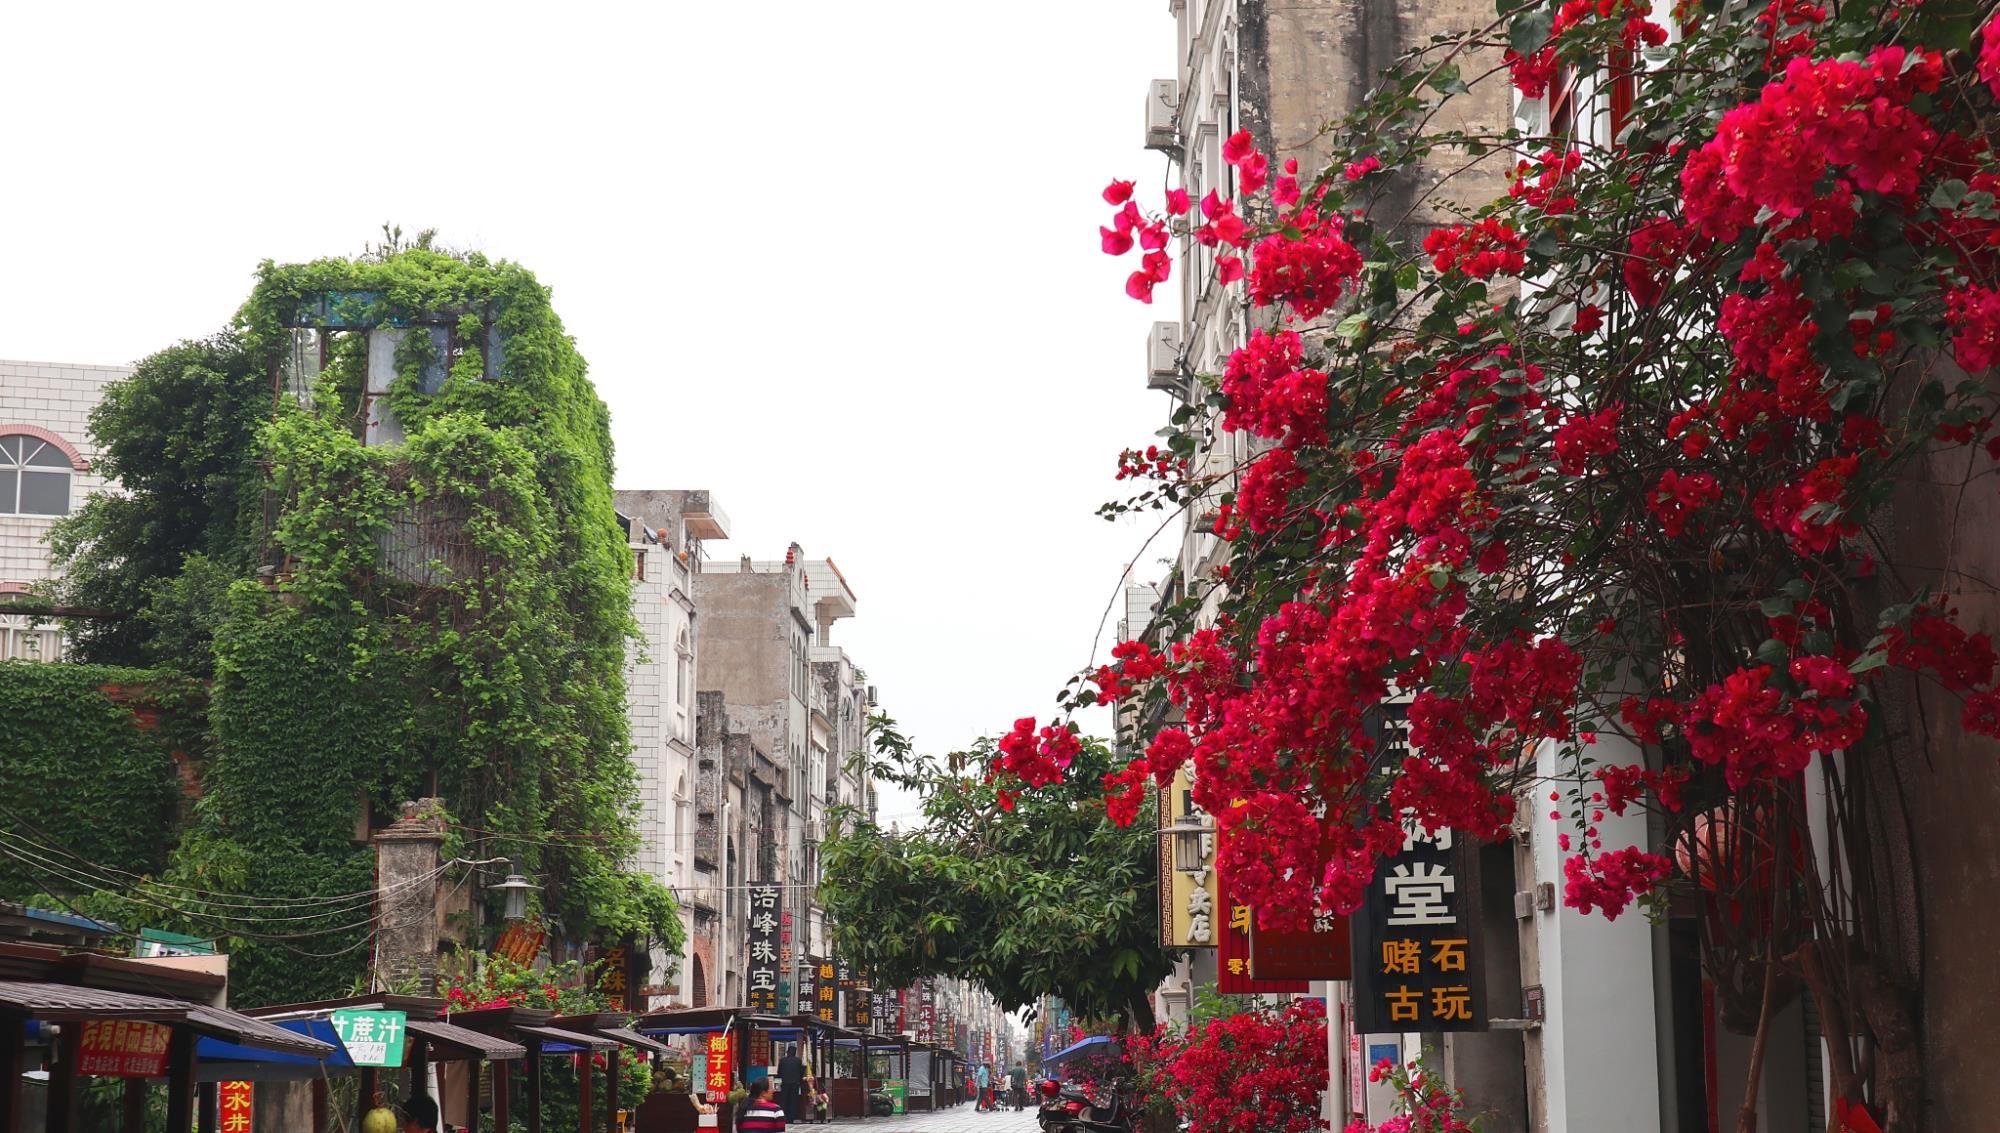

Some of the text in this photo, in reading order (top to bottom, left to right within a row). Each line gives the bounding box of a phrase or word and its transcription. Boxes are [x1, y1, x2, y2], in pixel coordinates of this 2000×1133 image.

[752, 884, 779, 992] 浩峰珠宝
[1382, 936, 1468, 975] 赌石
[1228, 958, 1251, 975] 零
[799, 967, 815, 1012] 南鞋
[819, 963, 834, 1022] 越南鞋
[1385, 985, 1473, 1022] 古玩
[331, 1015, 401, 1044] 甘蔗汁
[710, 1036, 729, 1088] 椰子冻
